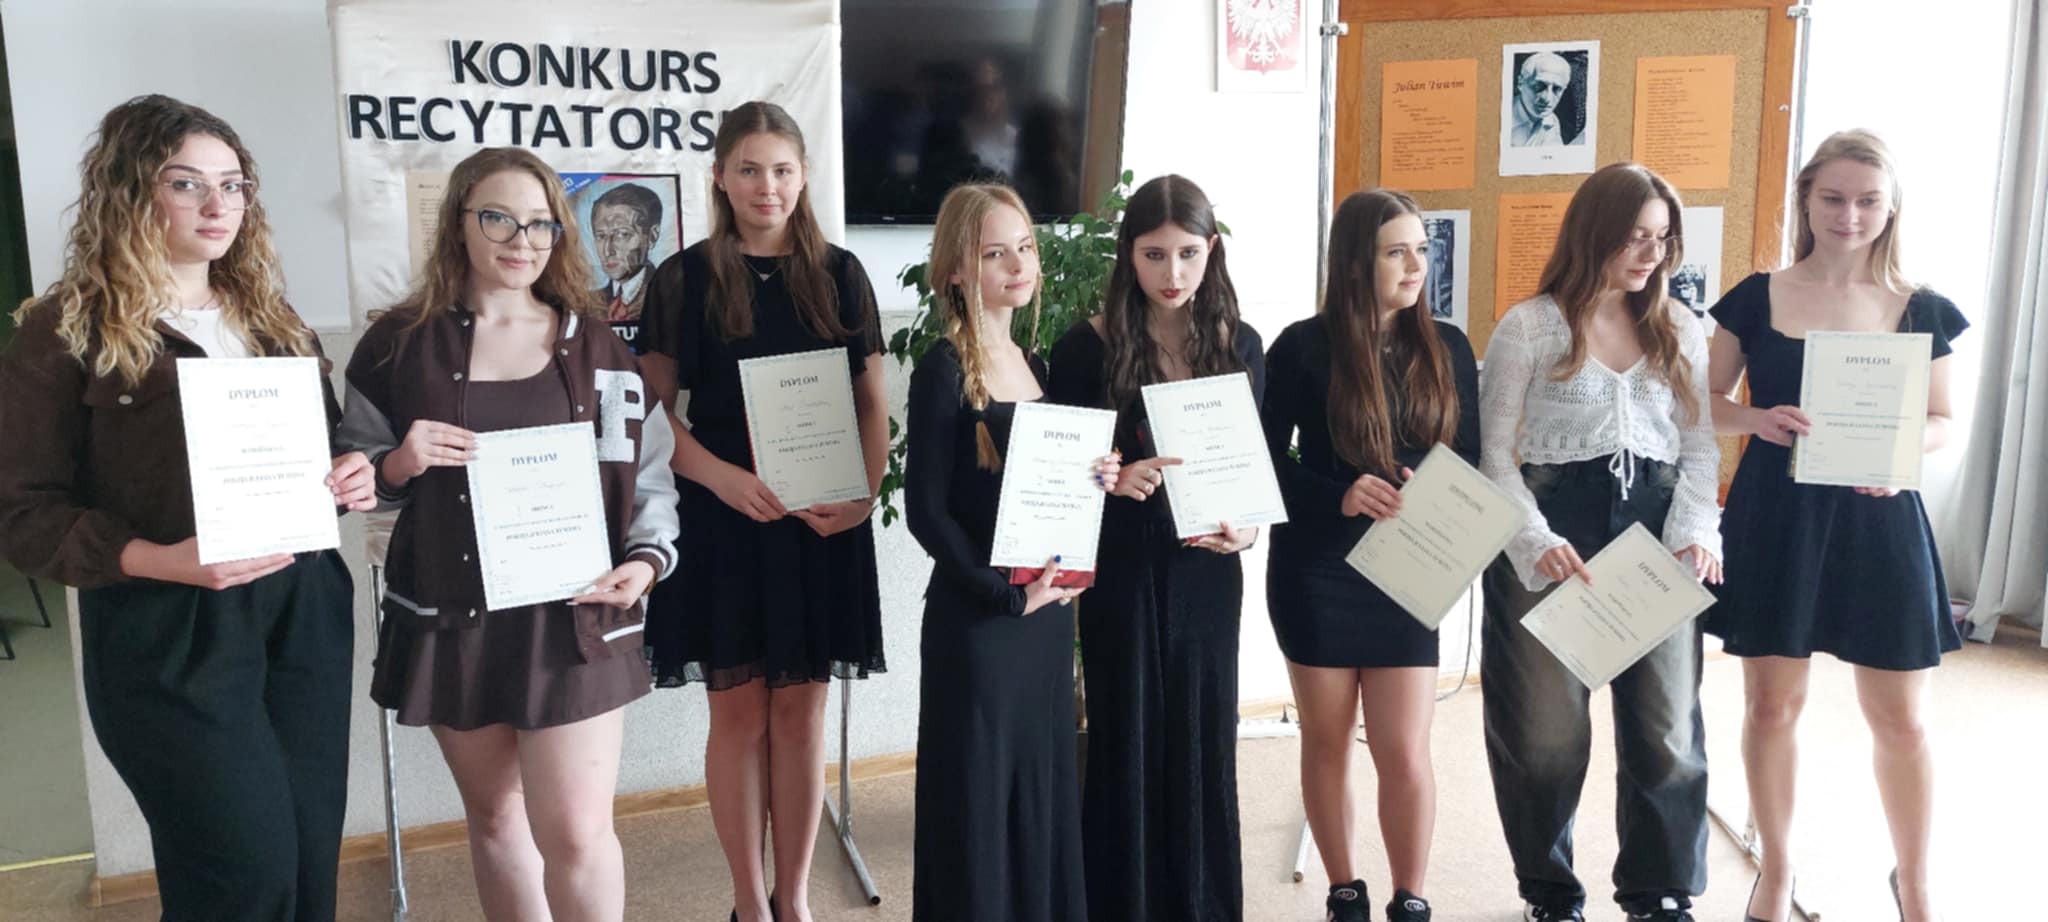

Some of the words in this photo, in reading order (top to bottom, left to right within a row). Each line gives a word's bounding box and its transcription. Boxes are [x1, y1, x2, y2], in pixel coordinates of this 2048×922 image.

[450, 40, 721, 94] KONKURS
[1391, 80, 1426, 94] Julian
[349, 94, 728, 151] RECYTATORS
[1845, 355, 1892, 366] DYPLOM
[228, 387, 280, 401] DYPLOM
[1183, 400, 1223, 413] DYPLOM
[594, 368, 646, 463] P
[510, 452, 559, 467] DYPLOM
